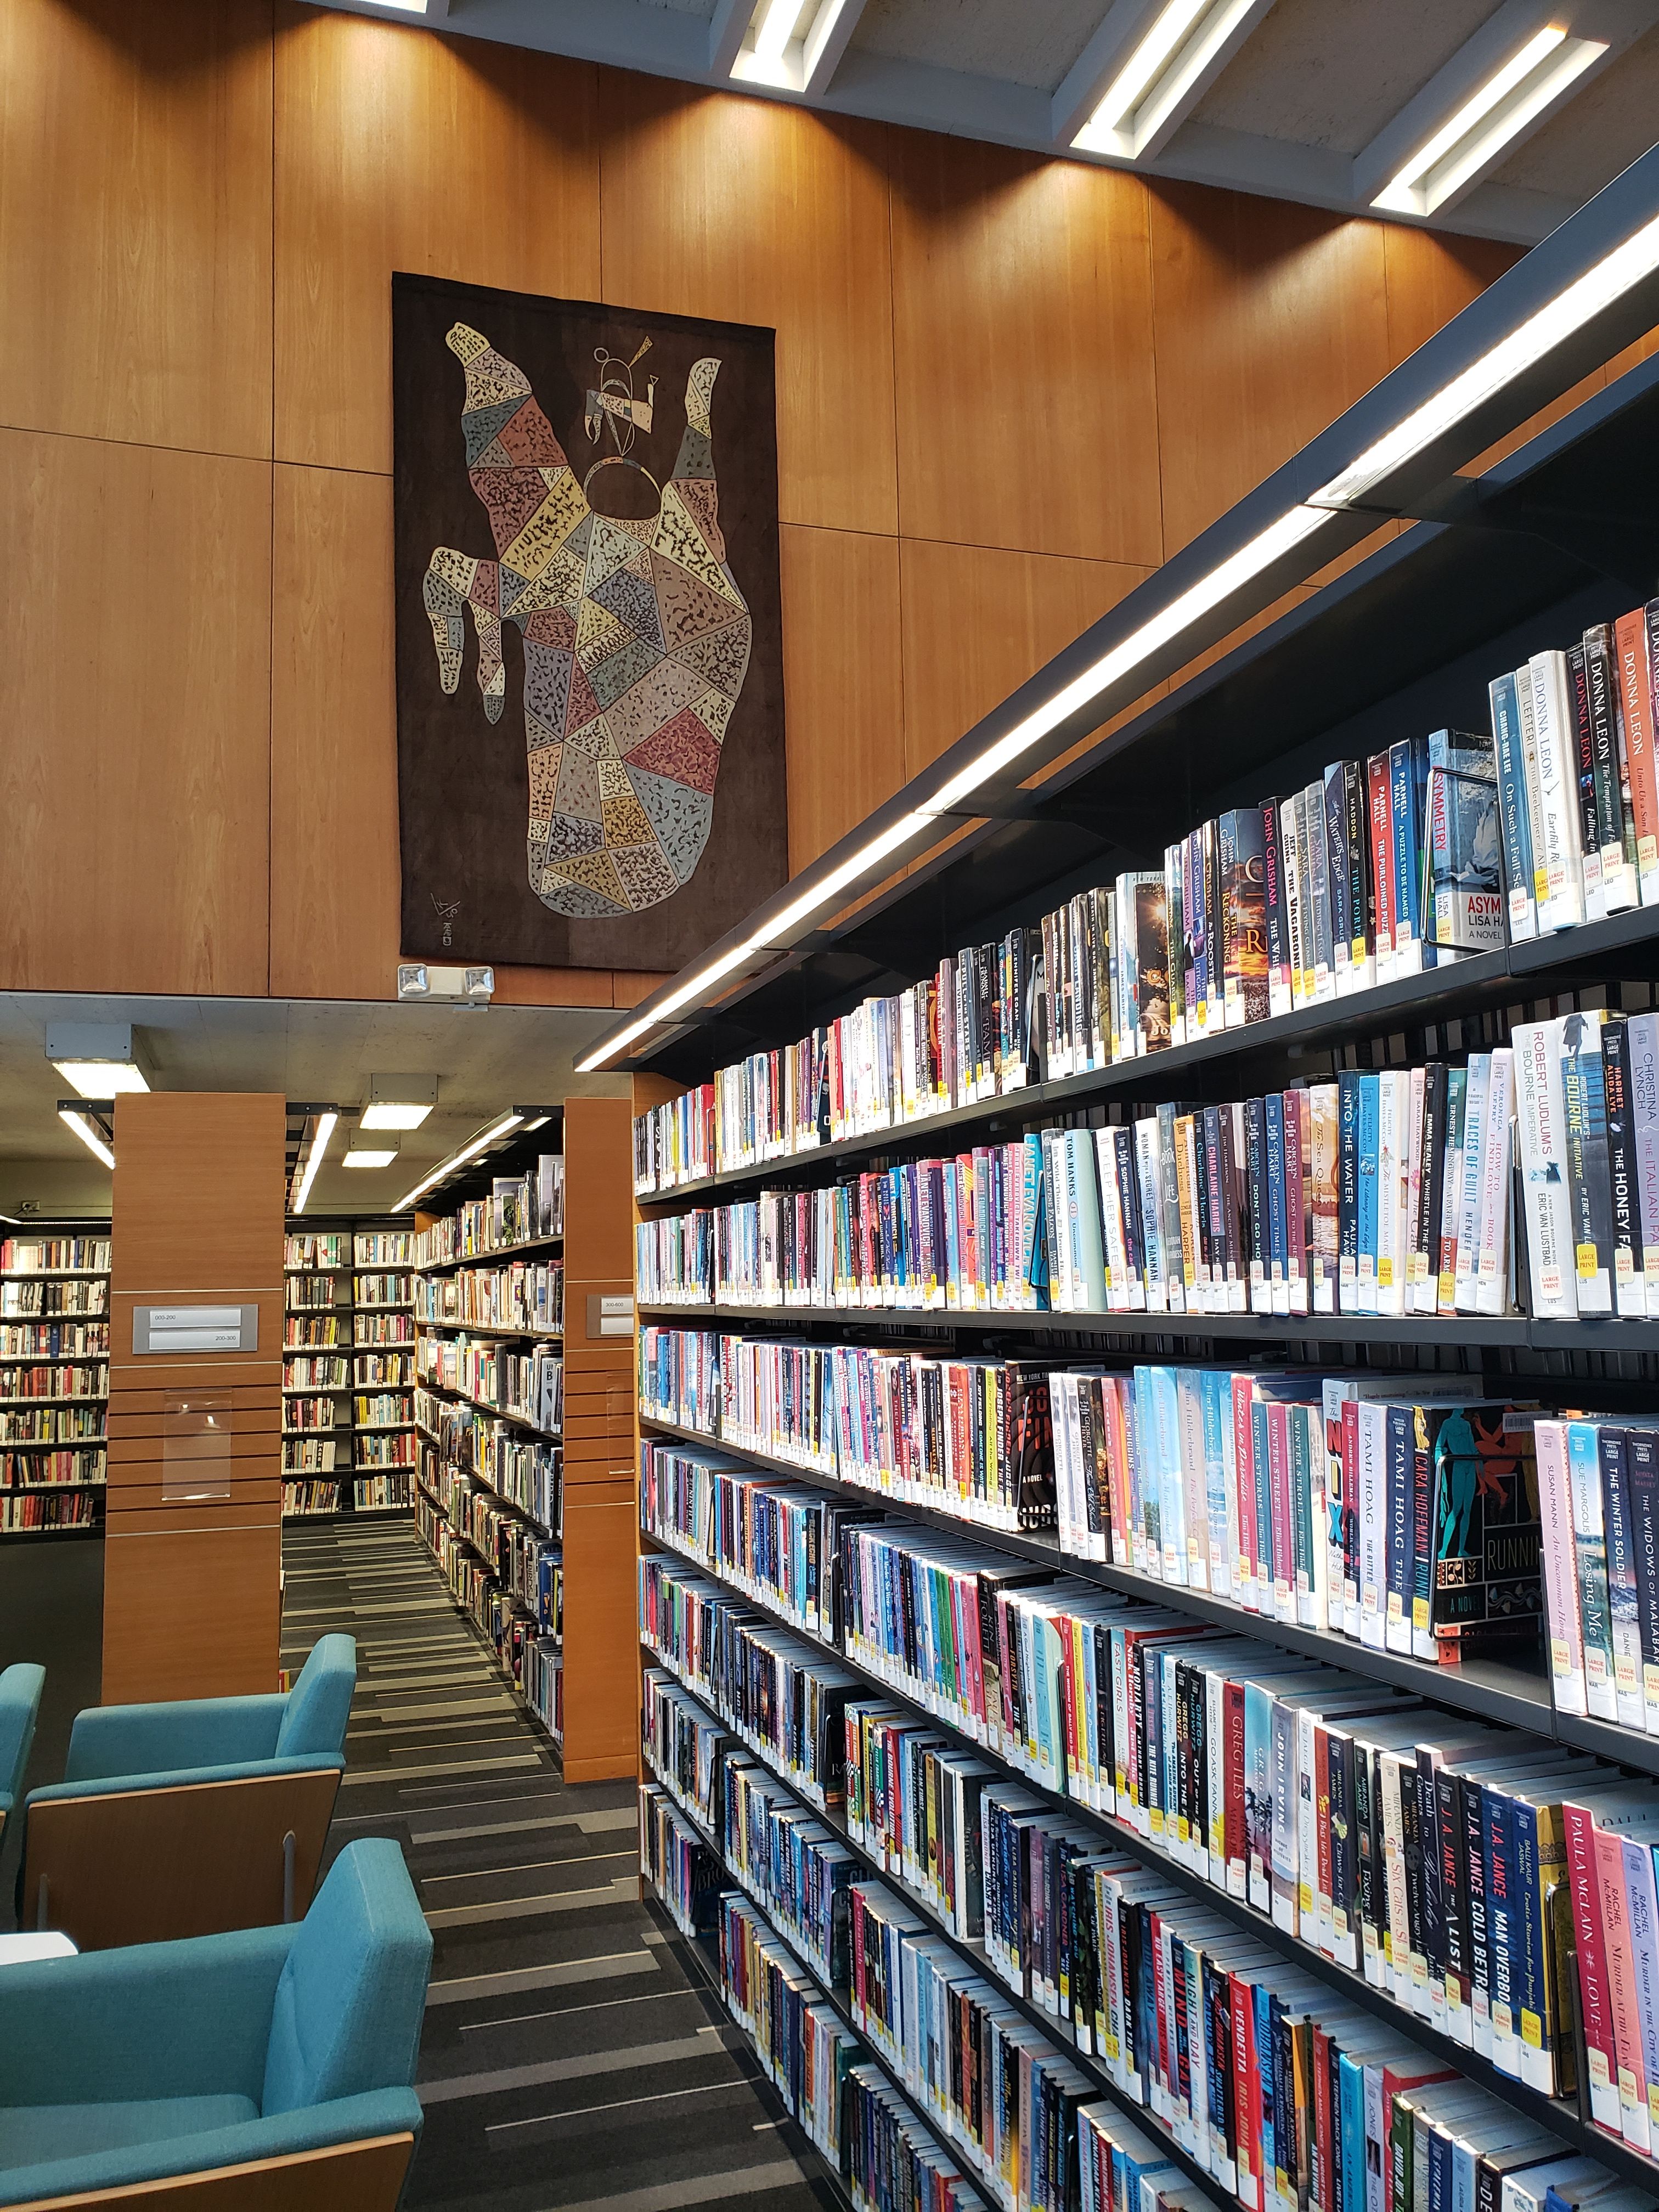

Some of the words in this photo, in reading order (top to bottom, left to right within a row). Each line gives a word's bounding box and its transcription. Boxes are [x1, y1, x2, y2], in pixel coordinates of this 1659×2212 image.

[1576, 674, 1587, 724] DONNA
[1592, 662, 1606, 716] DONNA
[1624, 652, 1640, 709] DONNA
[1523, 701, 1534, 746] LEFTERI
[1536, 682, 1549, 736] DONNA
[1579, 727, 1591, 769] LEON
[1596, 718, 1609, 760] LEON
[1630, 711, 1643, 755] LEON
[1541, 737, 1553, 780] LEON
[1378, 786, 1387, 832] PARNELL
[1399, 772, 1407, 819] PARNELL
[1505, 784, 1514, 803] On
[1263, 807, 1273, 842] JOHN
[1508, 803, 1517, 834] Such
[1548, 813, 1560, 853] Earthly
[1266, 847, 1277, 906] GRISHAM
[1511, 847, 1521, 872] Full
[1604, 853, 1620, 861] LARGE
[1605, 860, 1620, 868] PRINT
[1222, 892, 1231, 964] RECKONING
[1269, 918, 1278, 940] THE
[1469, 915, 1491, 926] LISA
[1476, 930, 1501, 939] NOVEL
[1523, 1050, 1535, 1101] BOURNE
[1533, 1031, 1548, 1091] ROBERT
[1344, 1090, 1352, 1122] INTO
[1566, 1075, 1582, 1135] BOURNE
[1615, 1068, 1624, 1109] HARRIET
[1635, 1068, 1646, 1109] LYNCH
[1644, 1053, 1657, 1121] CHRISTINA
[1344, 1126, 1353, 1152] THE
[1467, 1111, 1480, 1151] TRACES
[1526, 1104, 1538, 1156] IMPERATIVE
[1538, 1095, 1553, 1155] LUDLUM'S
[1024, 1143, 1035, 1186] JANET
[1067, 1162, 1076, 1197] HANKS
[1102, 1155, 1112, 1188] KEEP
[1176, 1144, 1184, 1192] Duchess
[1208, 1146, 1218, 1197] CHARLAINE
[1466, 1155, 1478, 1169] OF
[1572, 1137, 1583, 1180] INITIATIVE
[1615, 1148, 1624, 1170] THE
[1120, 1167, 1129, 1194] SOPHIE
[1344, 1159, 1353, 1204] WATER
[1464, 1173, 1477, 1204] GUILT
[1615, 1173, 1630, 1230] HONEY
[1106, 1194, 1115, 1222] HER
[1124, 1195, 1132, 1229] HANNAH
[1146, 1209, 1155, 1240] SOPHIE
[1211, 1198, 1220, 1233] HARRIS
[1423, 1216, 1429, 1226] IN
[1109, 1227, 1119, 1266] SAFE
[1254, 1222, 1260, 1239] GO
[1147, 1244, 1159, 1281] HANNAH
[1395, 1441, 1404, 1490] TAMI
[1415, 1456, 1428, 1488] CARA
[1548, 1465, 1556, 1496] SUSAN
[1609, 1468, 1618, 1489] THE
[1365, 1479, 1374, 1525] HOAG
[1395, 1496, 1404, 1549] HOAG
[1415, 1493, 1429, 1553] HOFFMAN
[1550, 1498, 1559, 1528] MANN
[1580, 1483, 1590, 1533] MARGOLIS
[1610, 1494, 1623, 1537] WINTER
[1615, 1540, 1627, 1589] SOLDIER
[1644, 1517, 1656, 1577] WIDOWS
[1395, 1559, 1403, 1590] THE
[1583, 1551, 1597, 1604] Losing
[1649, 1583, 1655, 1595] OF
[1450, 1601, 1454, 1613] A
[1458, 1595, 1481, 1612] NOVEL
[1588, 1611, 1602, 1637] Me
[1649, 1599, 1659, 1663] MALABAR
[1232, 1716, 1243, 1762] GREG
[1233, 1767, 1243, 1800] ILES
[1424, 1780, 1435, 1818] Death
[1571, 1816, 1587, 1870] PAULA
[1443, 1842, 1456, 1888] JANCE
[1469, 1846, 1483, 1897] JANCE
[1493, 1852, 1506, 1899] JANCE
[1472, 1901, 1486, 1943] COLD
[1577, 1876, 1594, 1944] MCLAIN
[1603, 1878, 1615, 1931] McMILLAN
[1611, 1888, 1621, 1926] RACHEL
[1630, 1885, 1642, 1939] McMILLAN
[1639, 1894, 1649, 1933] RACHEL
[1494, 1909, 1508, 1943] MAN
[1449, 1927, 1461, 1972] LIST
[1174, 1967, 1187, 2028] MIND
[1587, 1976, 1602, 2027] LOVE
